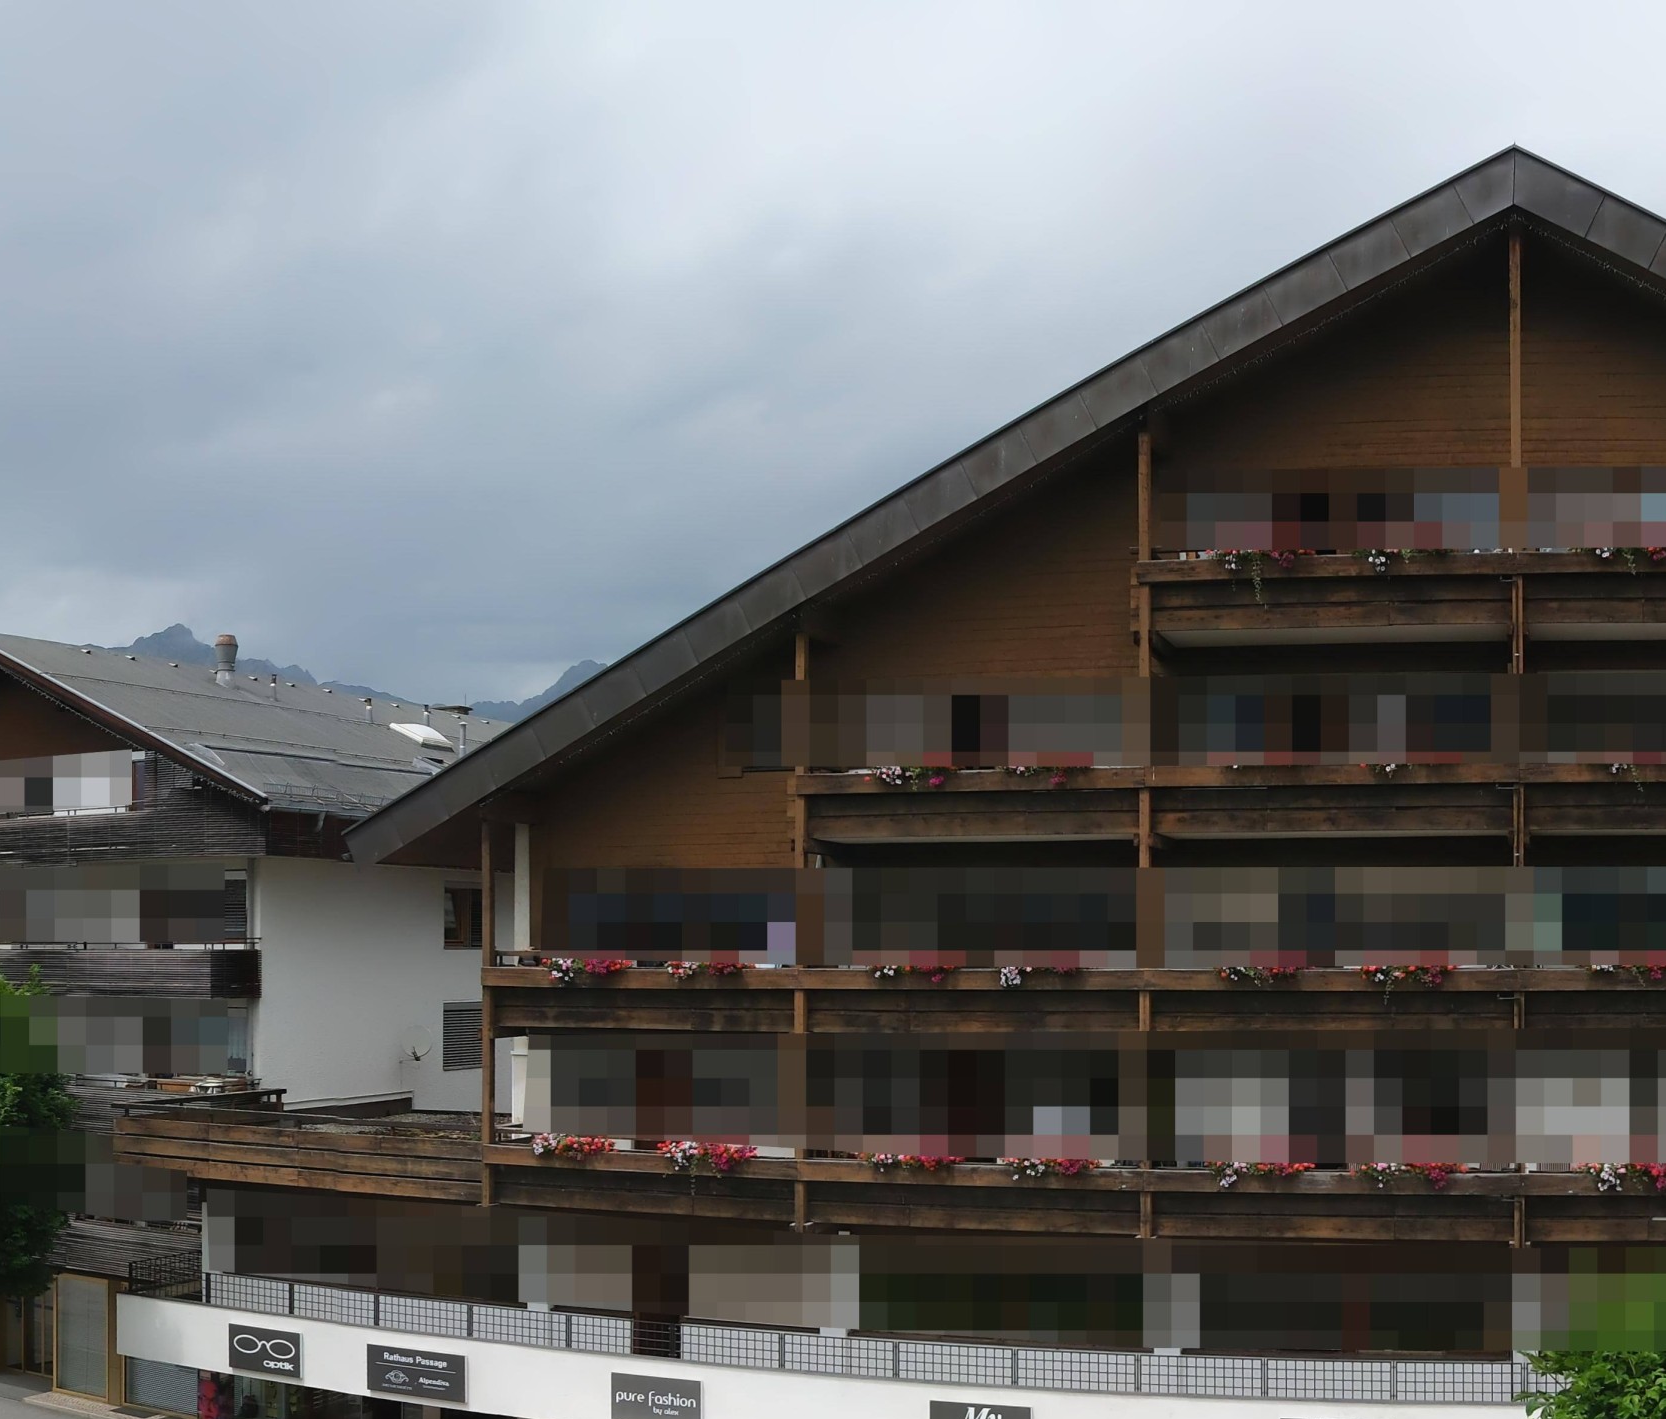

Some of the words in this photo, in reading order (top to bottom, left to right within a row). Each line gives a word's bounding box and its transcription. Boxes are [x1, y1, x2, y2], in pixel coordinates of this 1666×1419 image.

[263, 1359, 294, 1371] optik
[383, 1352, 414, 1364] Rathaus
[416, 1356, 447, 1369] Passage
[615, 1390, 645, 1404] pure
[647, 1390, 697, 1409] fashion
[652, 1406, 663, 1416] by
[664, 1407, 680, 1416] alex
